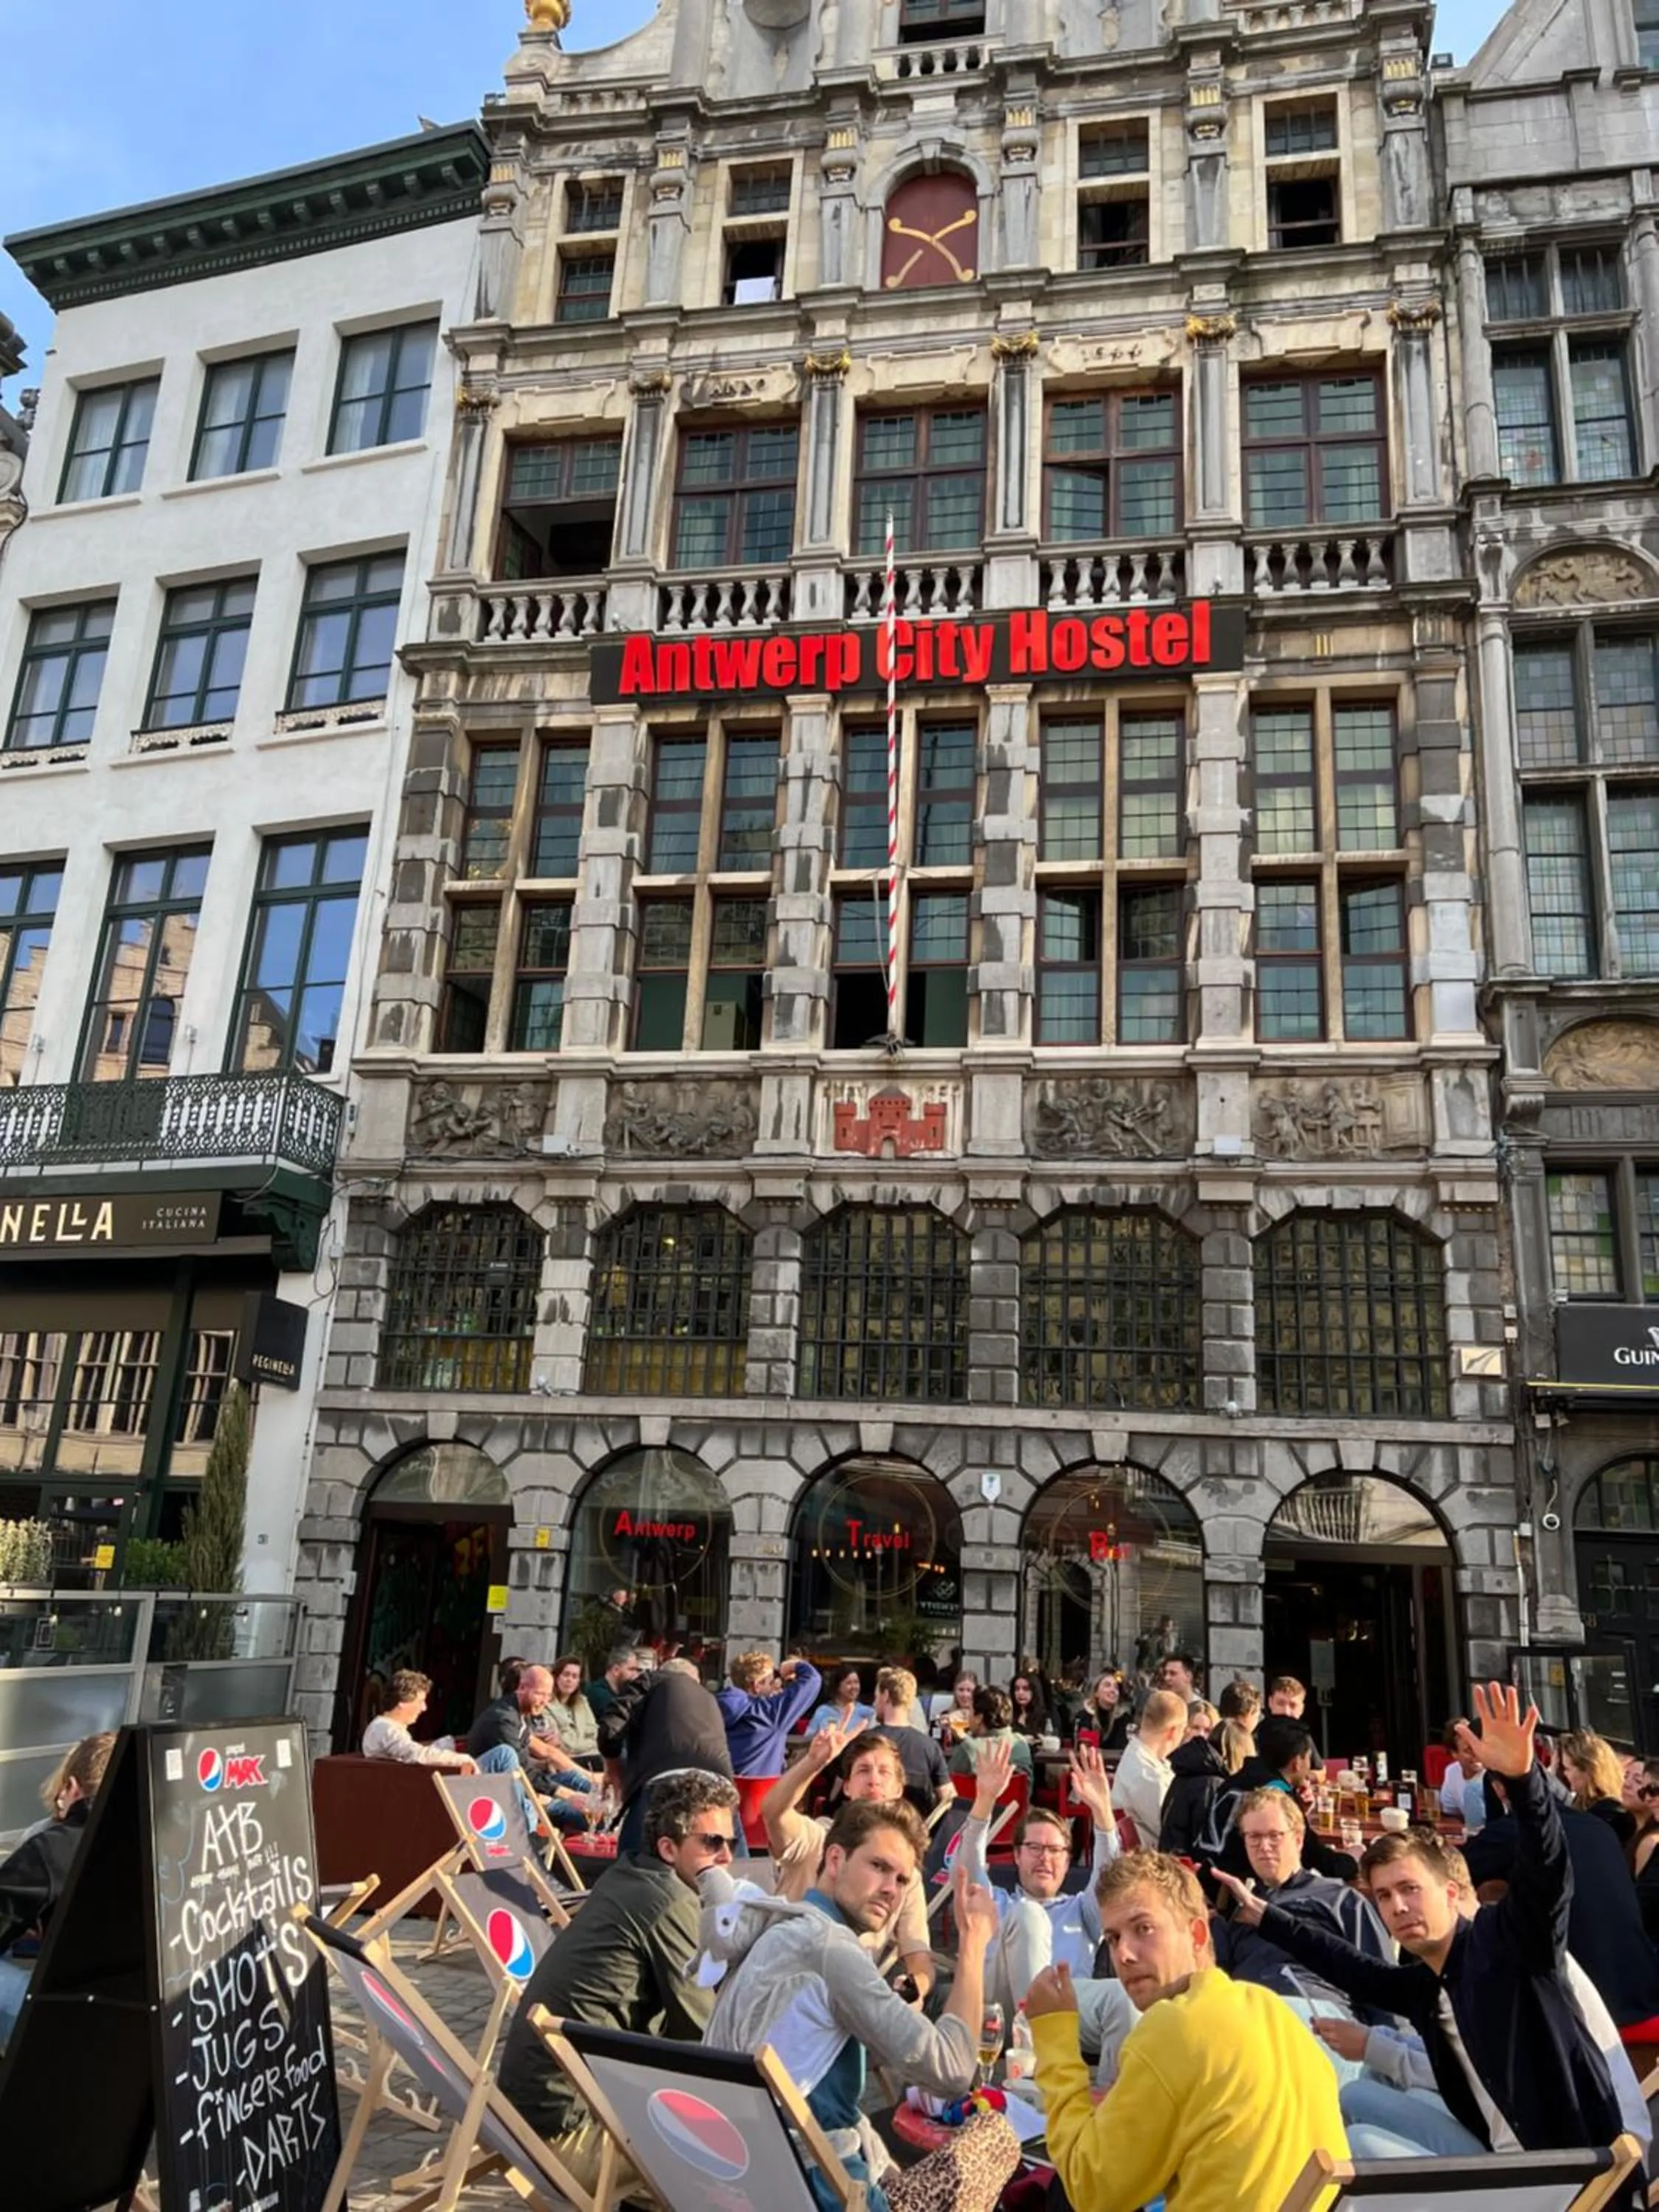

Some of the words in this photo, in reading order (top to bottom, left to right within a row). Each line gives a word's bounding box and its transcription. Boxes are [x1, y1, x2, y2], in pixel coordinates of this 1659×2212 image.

[619, 632, 861, 695] Antwerp
[876, 618, 995, 683] City
[1009, 599, 1211, 674] Hostel
[0, 1202, 114, 1243] NELLA
[142, 1220, 206, 1230] ITALIANA
[156, 1206, 207, 1217] CUCINA
[613, 1510, 695, 1542] Antwerp
[846, 1520, 910, 1550] Travel
